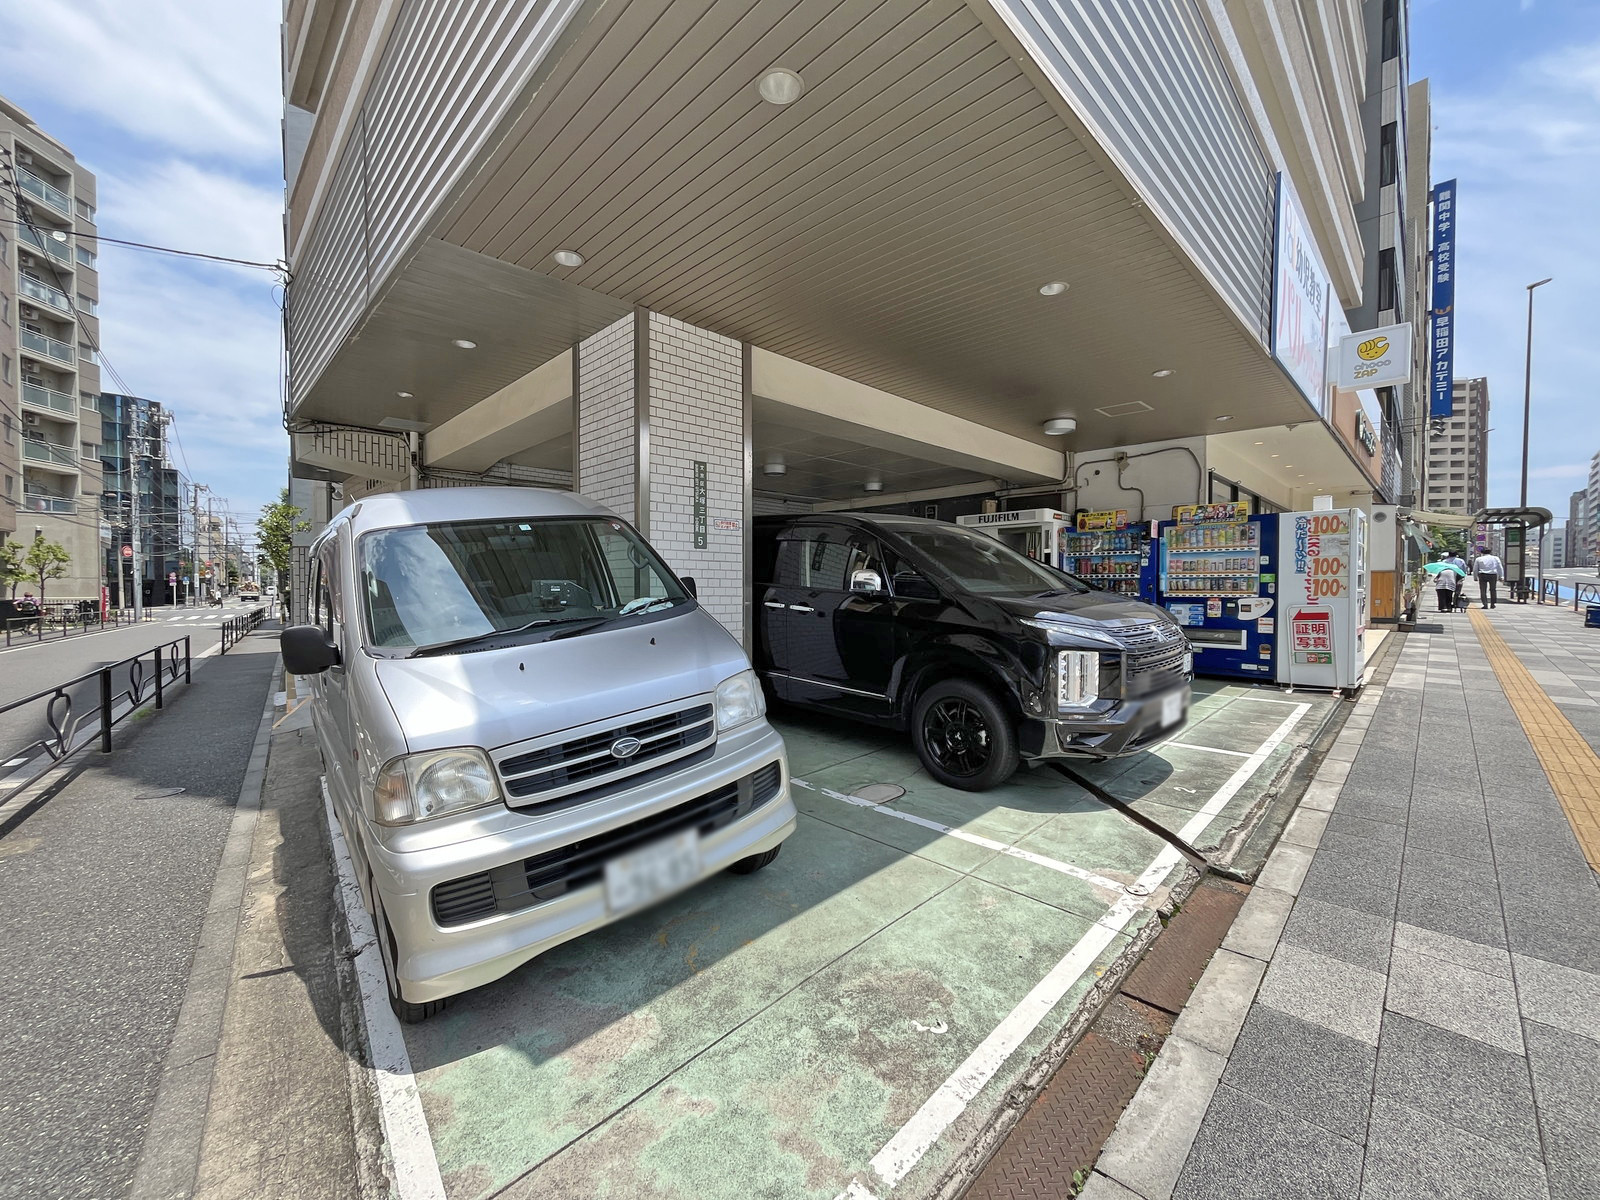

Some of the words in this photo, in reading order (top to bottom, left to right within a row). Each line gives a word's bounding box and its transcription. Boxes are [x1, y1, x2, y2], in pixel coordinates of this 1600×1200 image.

[1435, 316, 1449, 400] 早稲田アカデミー
[1353, 368, 1378, 380] ZAP
[978, 512, 1020, 524] FUJIFILM
[697, 536, 704, 546] 5
[1295, 623, 1326, 635] 証明
[1296, 636, 1327, 648] 写真
